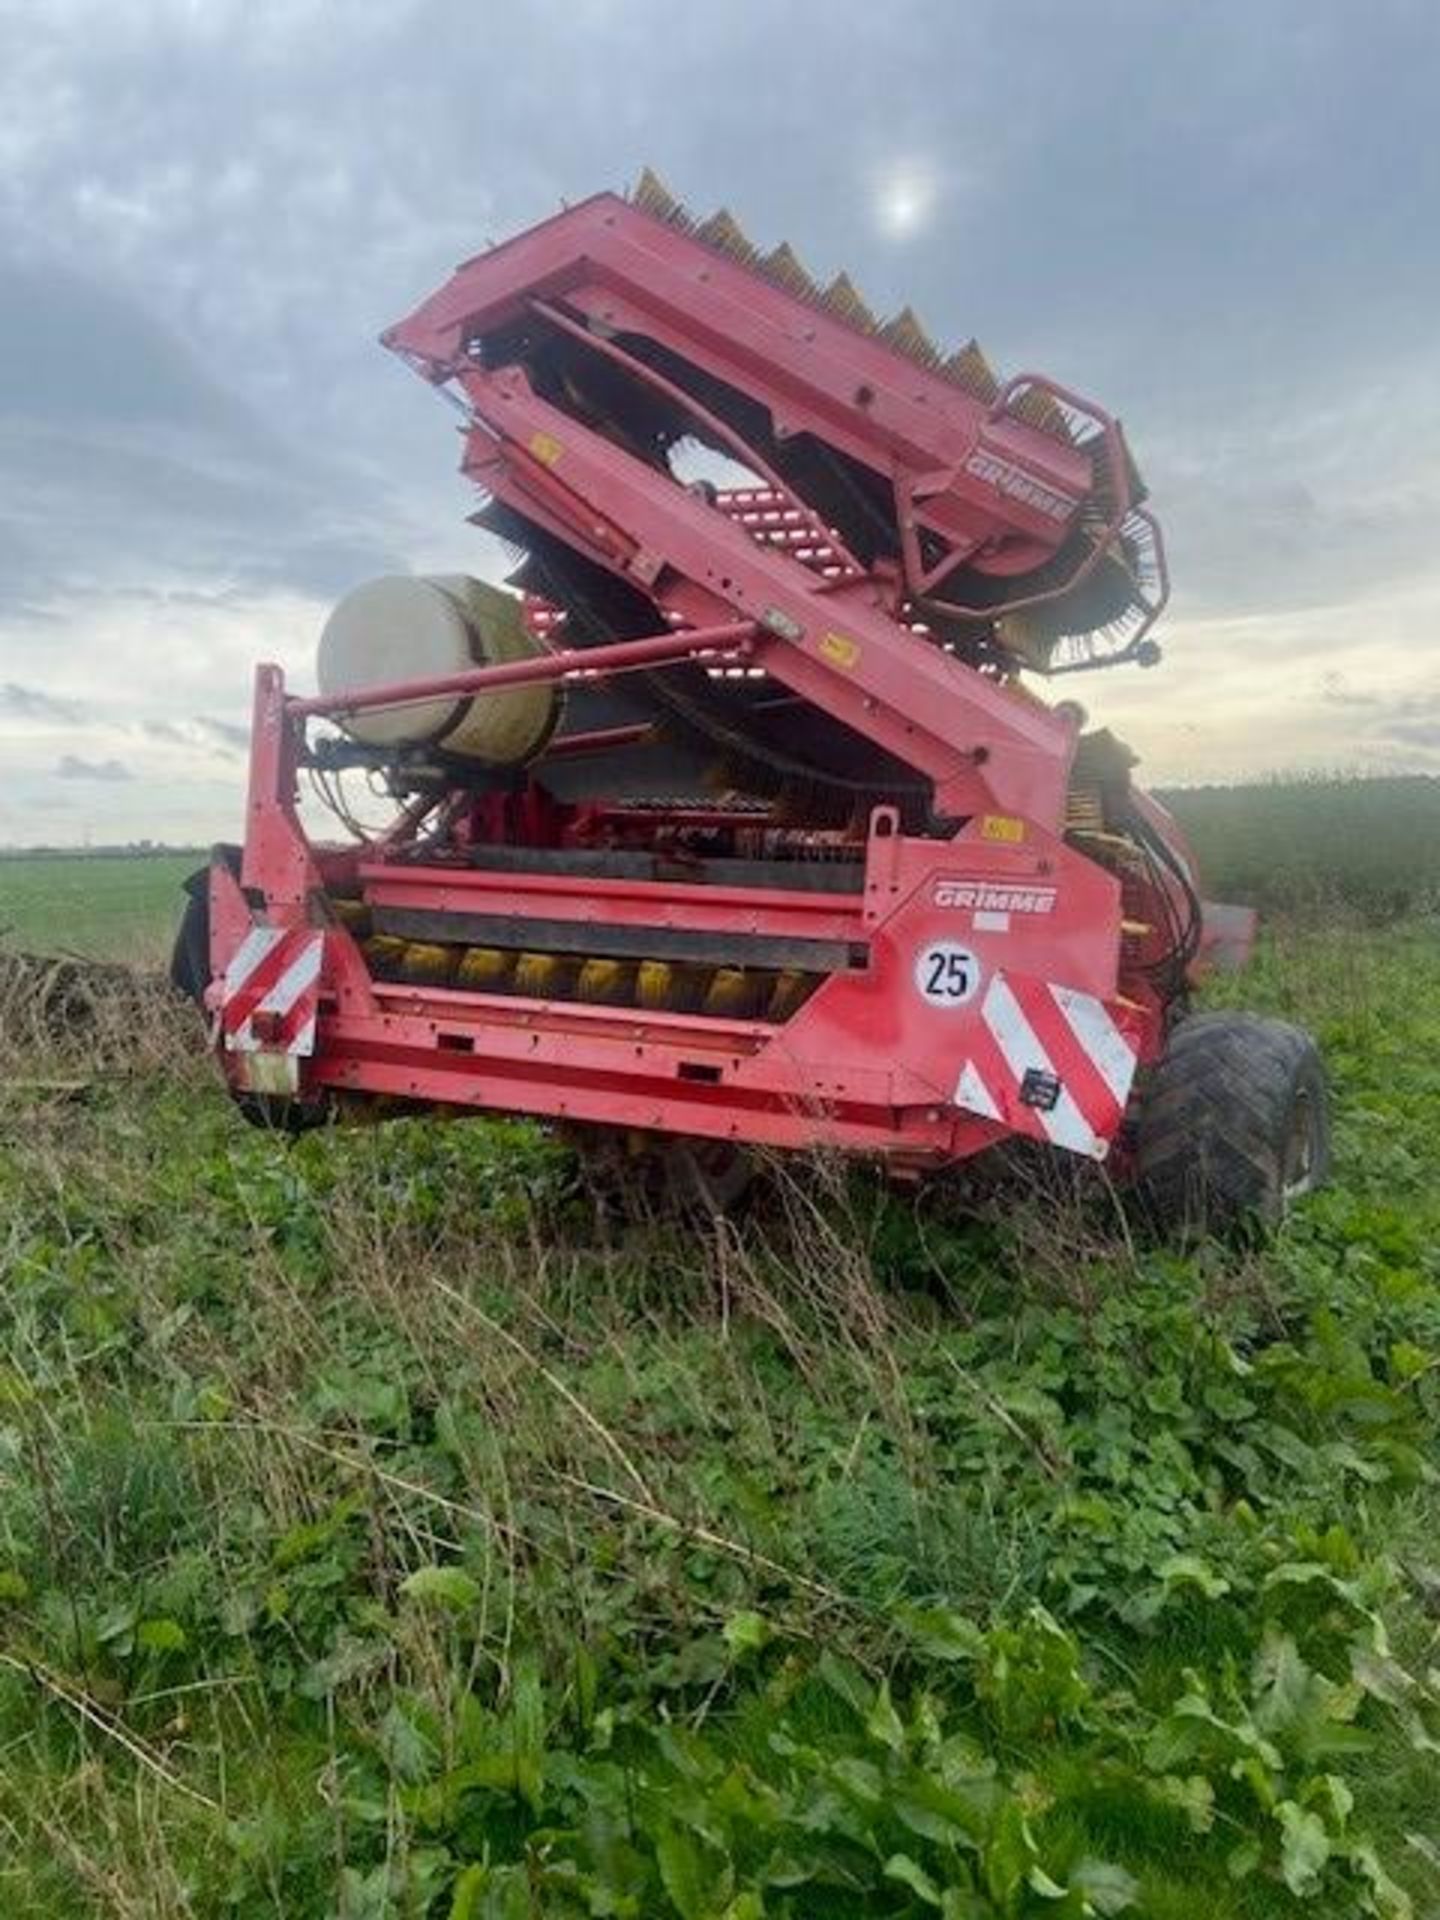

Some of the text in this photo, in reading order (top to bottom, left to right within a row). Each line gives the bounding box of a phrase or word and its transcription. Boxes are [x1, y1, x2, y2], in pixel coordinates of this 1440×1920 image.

[965, 453, 1076, 521] GRIMME
[933, 883, 1056, 912] GRIMME
[926, 951, 970, 997] 25
